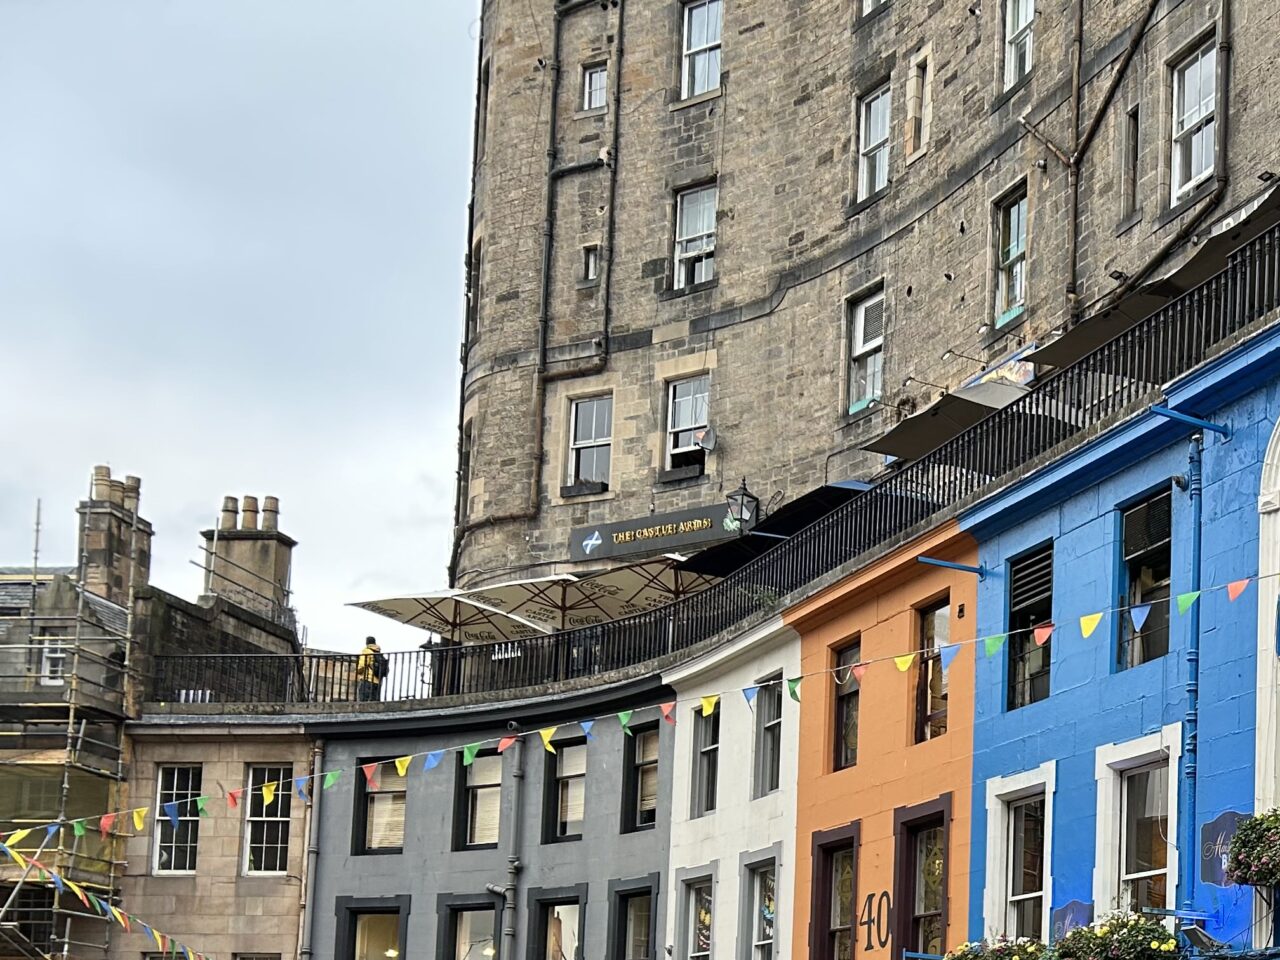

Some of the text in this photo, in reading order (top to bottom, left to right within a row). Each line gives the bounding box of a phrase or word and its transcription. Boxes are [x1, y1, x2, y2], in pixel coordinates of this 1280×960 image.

[612, 518, 713, 543] THE CASTLE ARMS
[860, 890, 891, 951] 40
